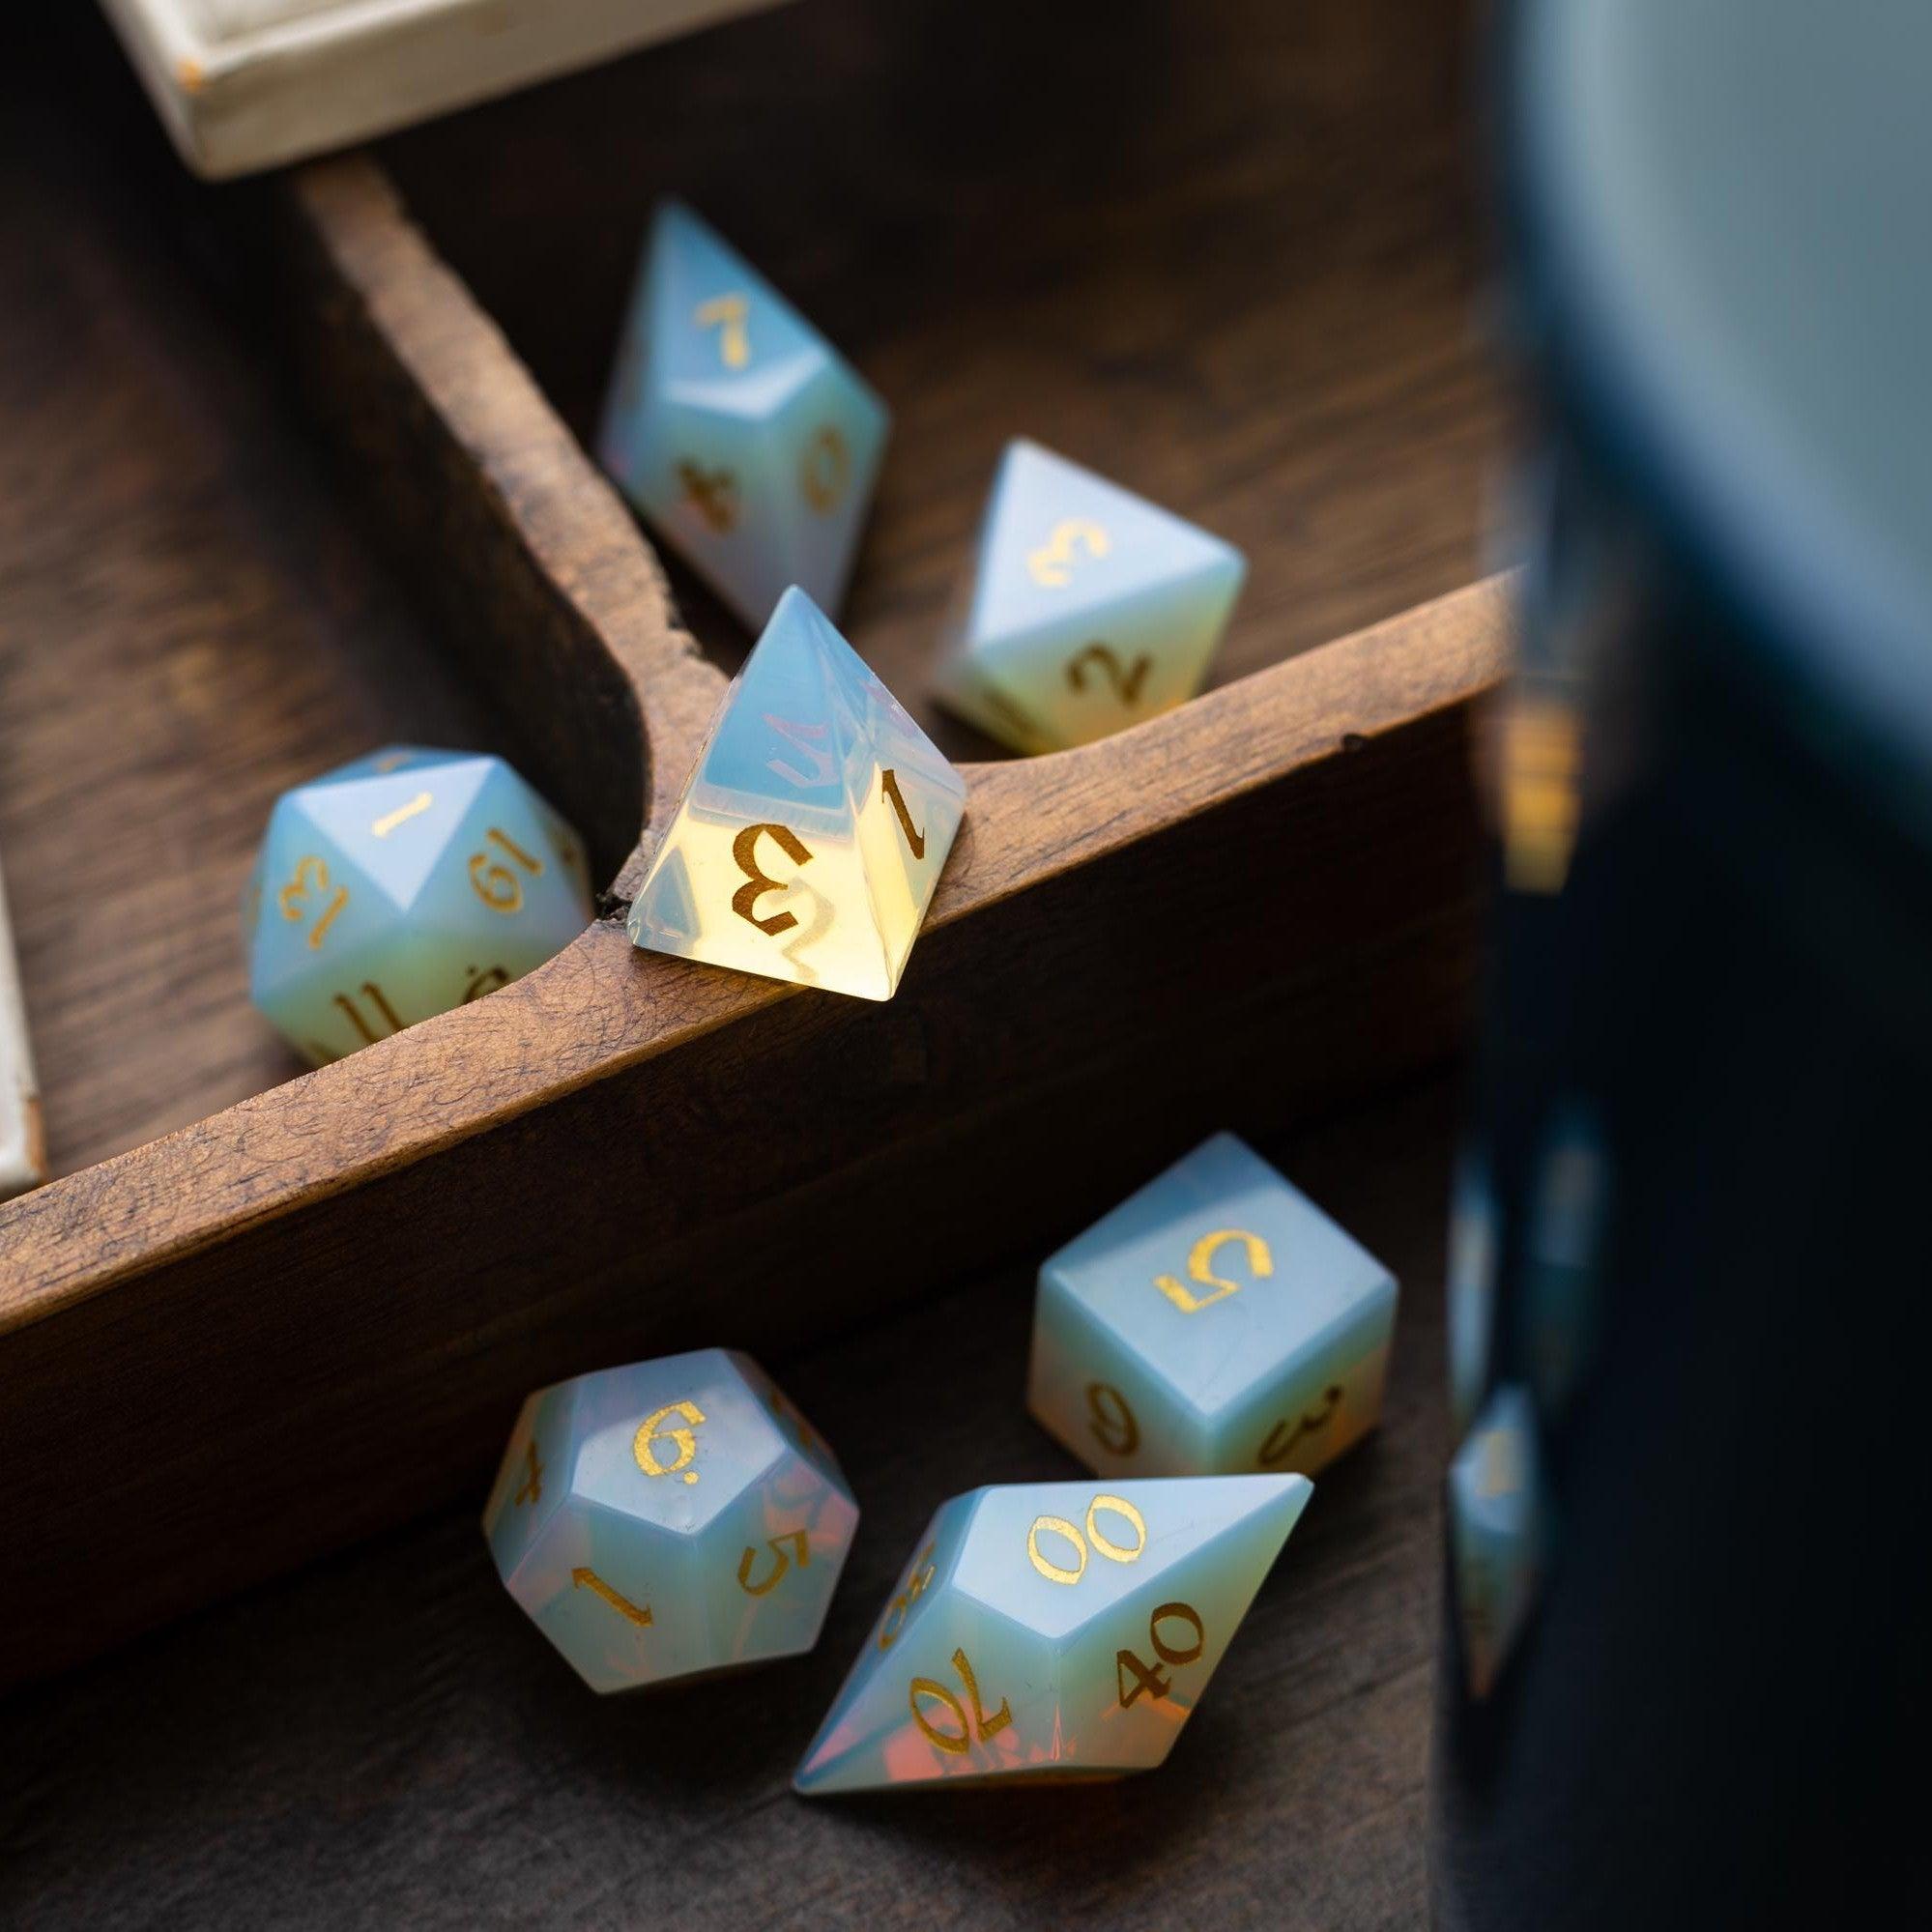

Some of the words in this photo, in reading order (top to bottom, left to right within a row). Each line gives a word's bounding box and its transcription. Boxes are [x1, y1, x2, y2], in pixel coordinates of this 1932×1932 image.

[693, 294, 750, 371] 7
[1024, 516, 1111, 588] 3
[1064, 640, 1156, 708] 2
[881, 769, 925, 859] 1
[278, 855, 351, 951] 13
[467, 826, 545, 913] 19
[732, 823, 814, 937] 3
[1152, 1227, 1275, 1315] 5
[737, 1529, 812, 1598] 5
[1026, 1492, 1148, 1586] 00
[571, 1567, 655, 1628] 1
[1116, 1601, 1206, 1710] 40
[908, 1647, 1014, 1755] 70
